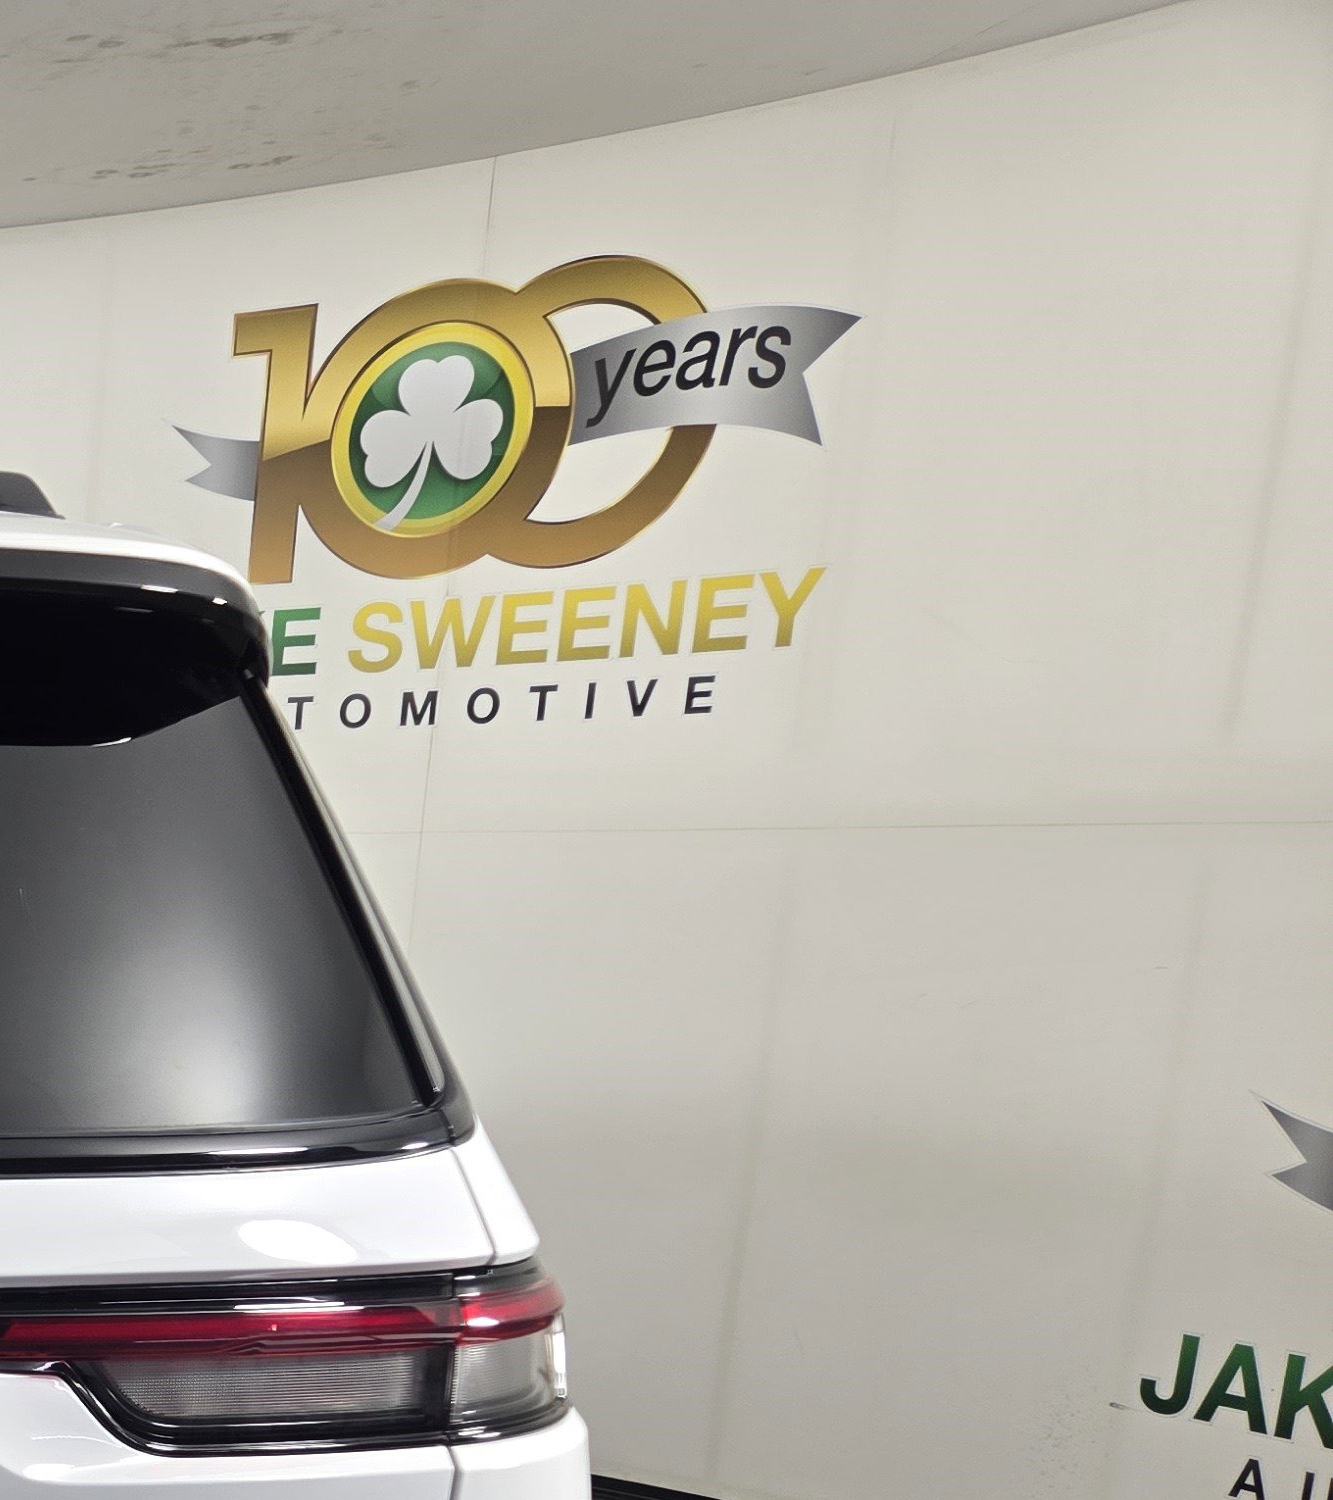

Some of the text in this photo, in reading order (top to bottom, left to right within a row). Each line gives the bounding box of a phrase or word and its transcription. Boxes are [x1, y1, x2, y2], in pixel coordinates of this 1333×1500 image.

[586, 323, 792, 427] years
[259, 566, 827, 677] E SWEENEY
[287, 675, 717, 731] TOMOTIVE
